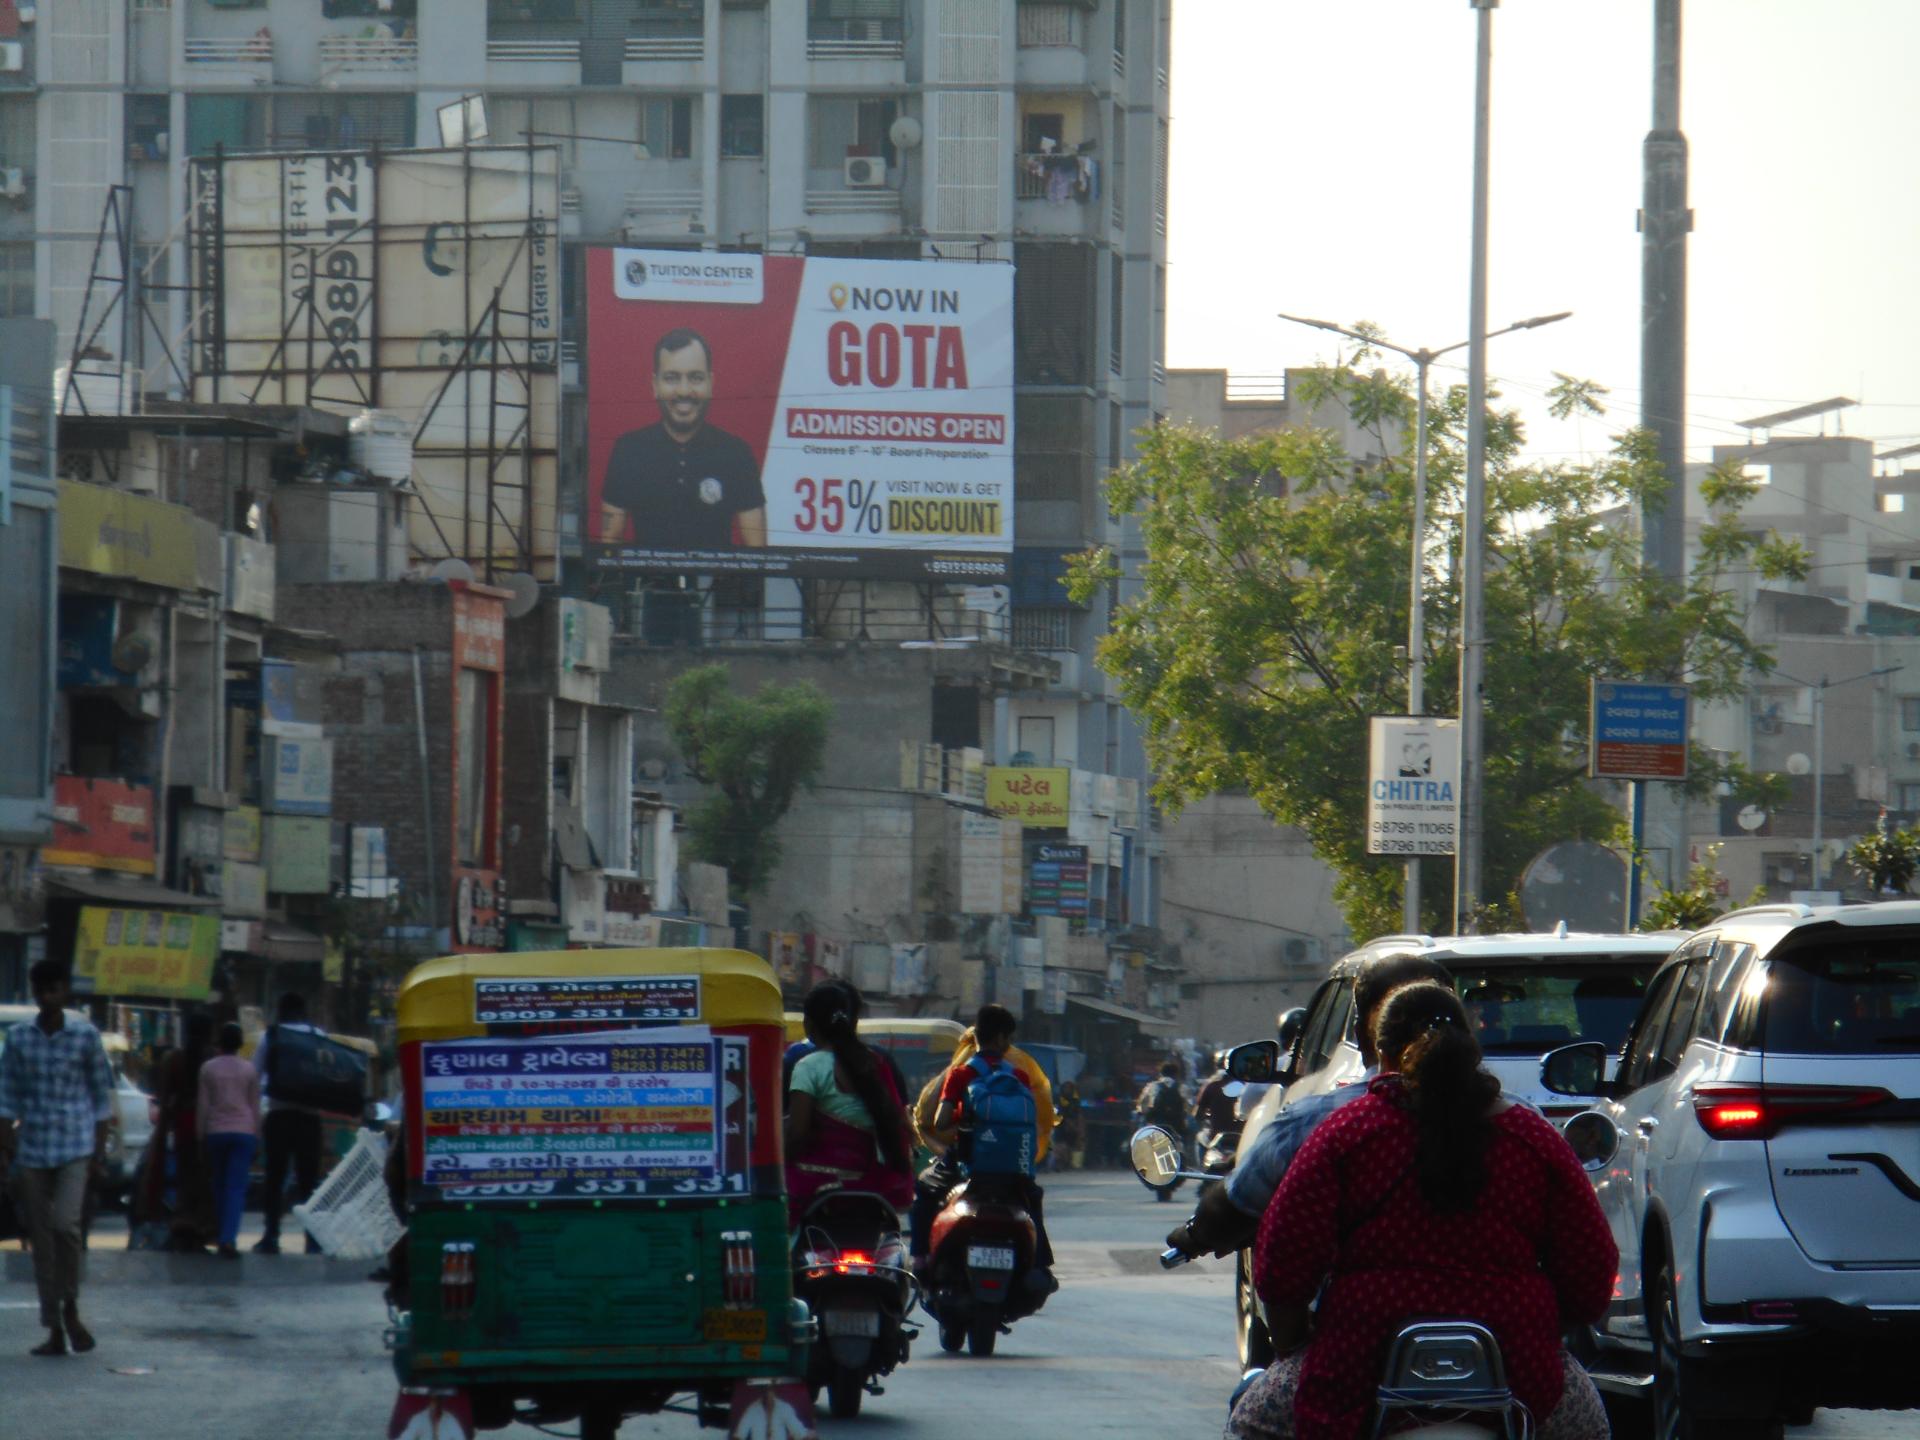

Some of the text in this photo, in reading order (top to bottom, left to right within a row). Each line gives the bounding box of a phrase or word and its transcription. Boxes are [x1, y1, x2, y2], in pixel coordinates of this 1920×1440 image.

[650, 264, 754, 279] TUITION CENTER
[852, 287, 960, 314] NOW IN
[828, 320, 969, 390] GOTA
[791, 413, 1002, 440] ADMISSIONS OPEN
[803, 444, 845, 456] Classes
[889, 447, 923, 459] Board
[925, 448, 990, 461] Preparation
[886, 480, 1002, 496] VISIT NOW & GET
[794, 477, 883, 535] 35%
[888, 499, 998, 534] DISCOUNT
[1005, 774, 1051, 795] પટેલ
[1373, 780, 1454, 801] CHITRA
[1393, 803, 1424, 811] PRIVATE
[1426, 804, 1456, 812] LIMITED
[1372, 821, 1455, 835] 98796 11065
[1372, 839, 1415, 851] 98796
[479, 1007, 696, 1021] 9909 331 331
[429, 1047, 607, 1076] કૃણાલ ટ્રાવેલ્સ
[611, 1048, 657, 1060] 94273
[430, 1109, 528, 1124] ચારધામ
[541, 1108, 600, 1122] યાત્રા
[488, 1153, 578, 1169] કાશ્મીર
[673, 1173, 744, 1193] 331
